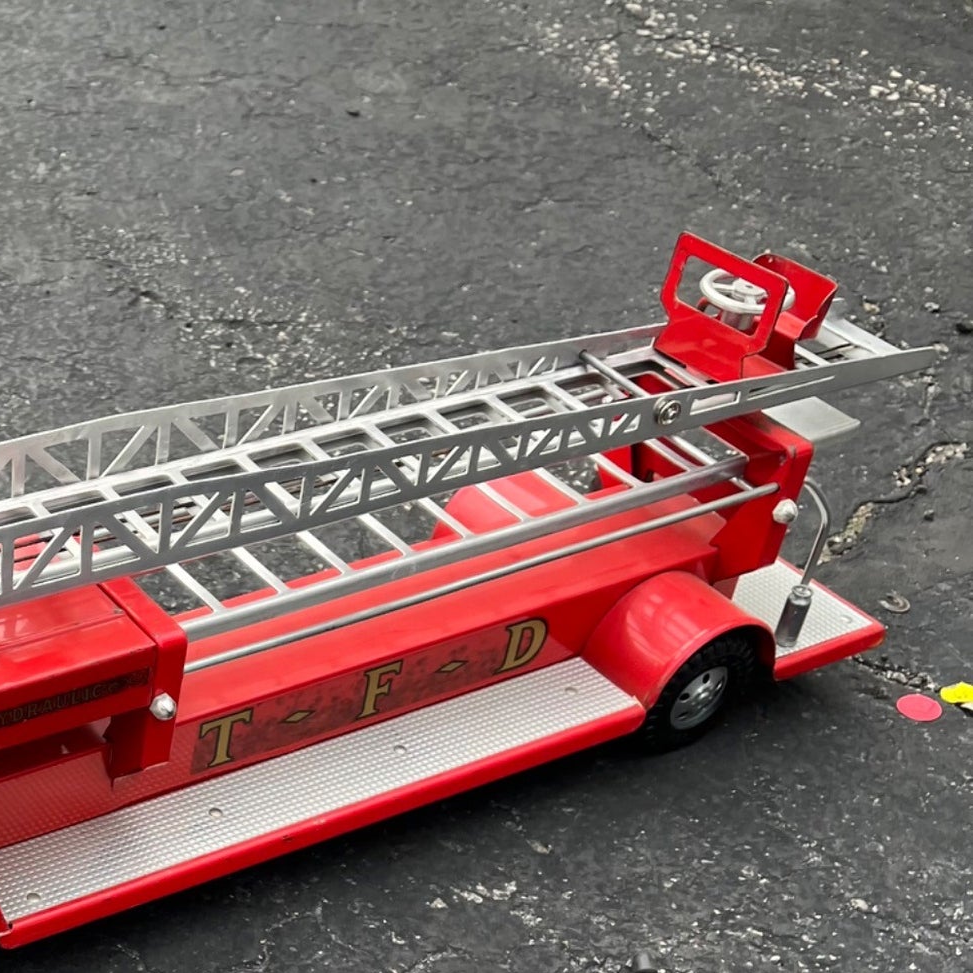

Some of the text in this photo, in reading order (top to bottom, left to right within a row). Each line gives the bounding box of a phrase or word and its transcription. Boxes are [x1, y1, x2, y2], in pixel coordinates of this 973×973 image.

[199, 616, 549, 768] T F D
